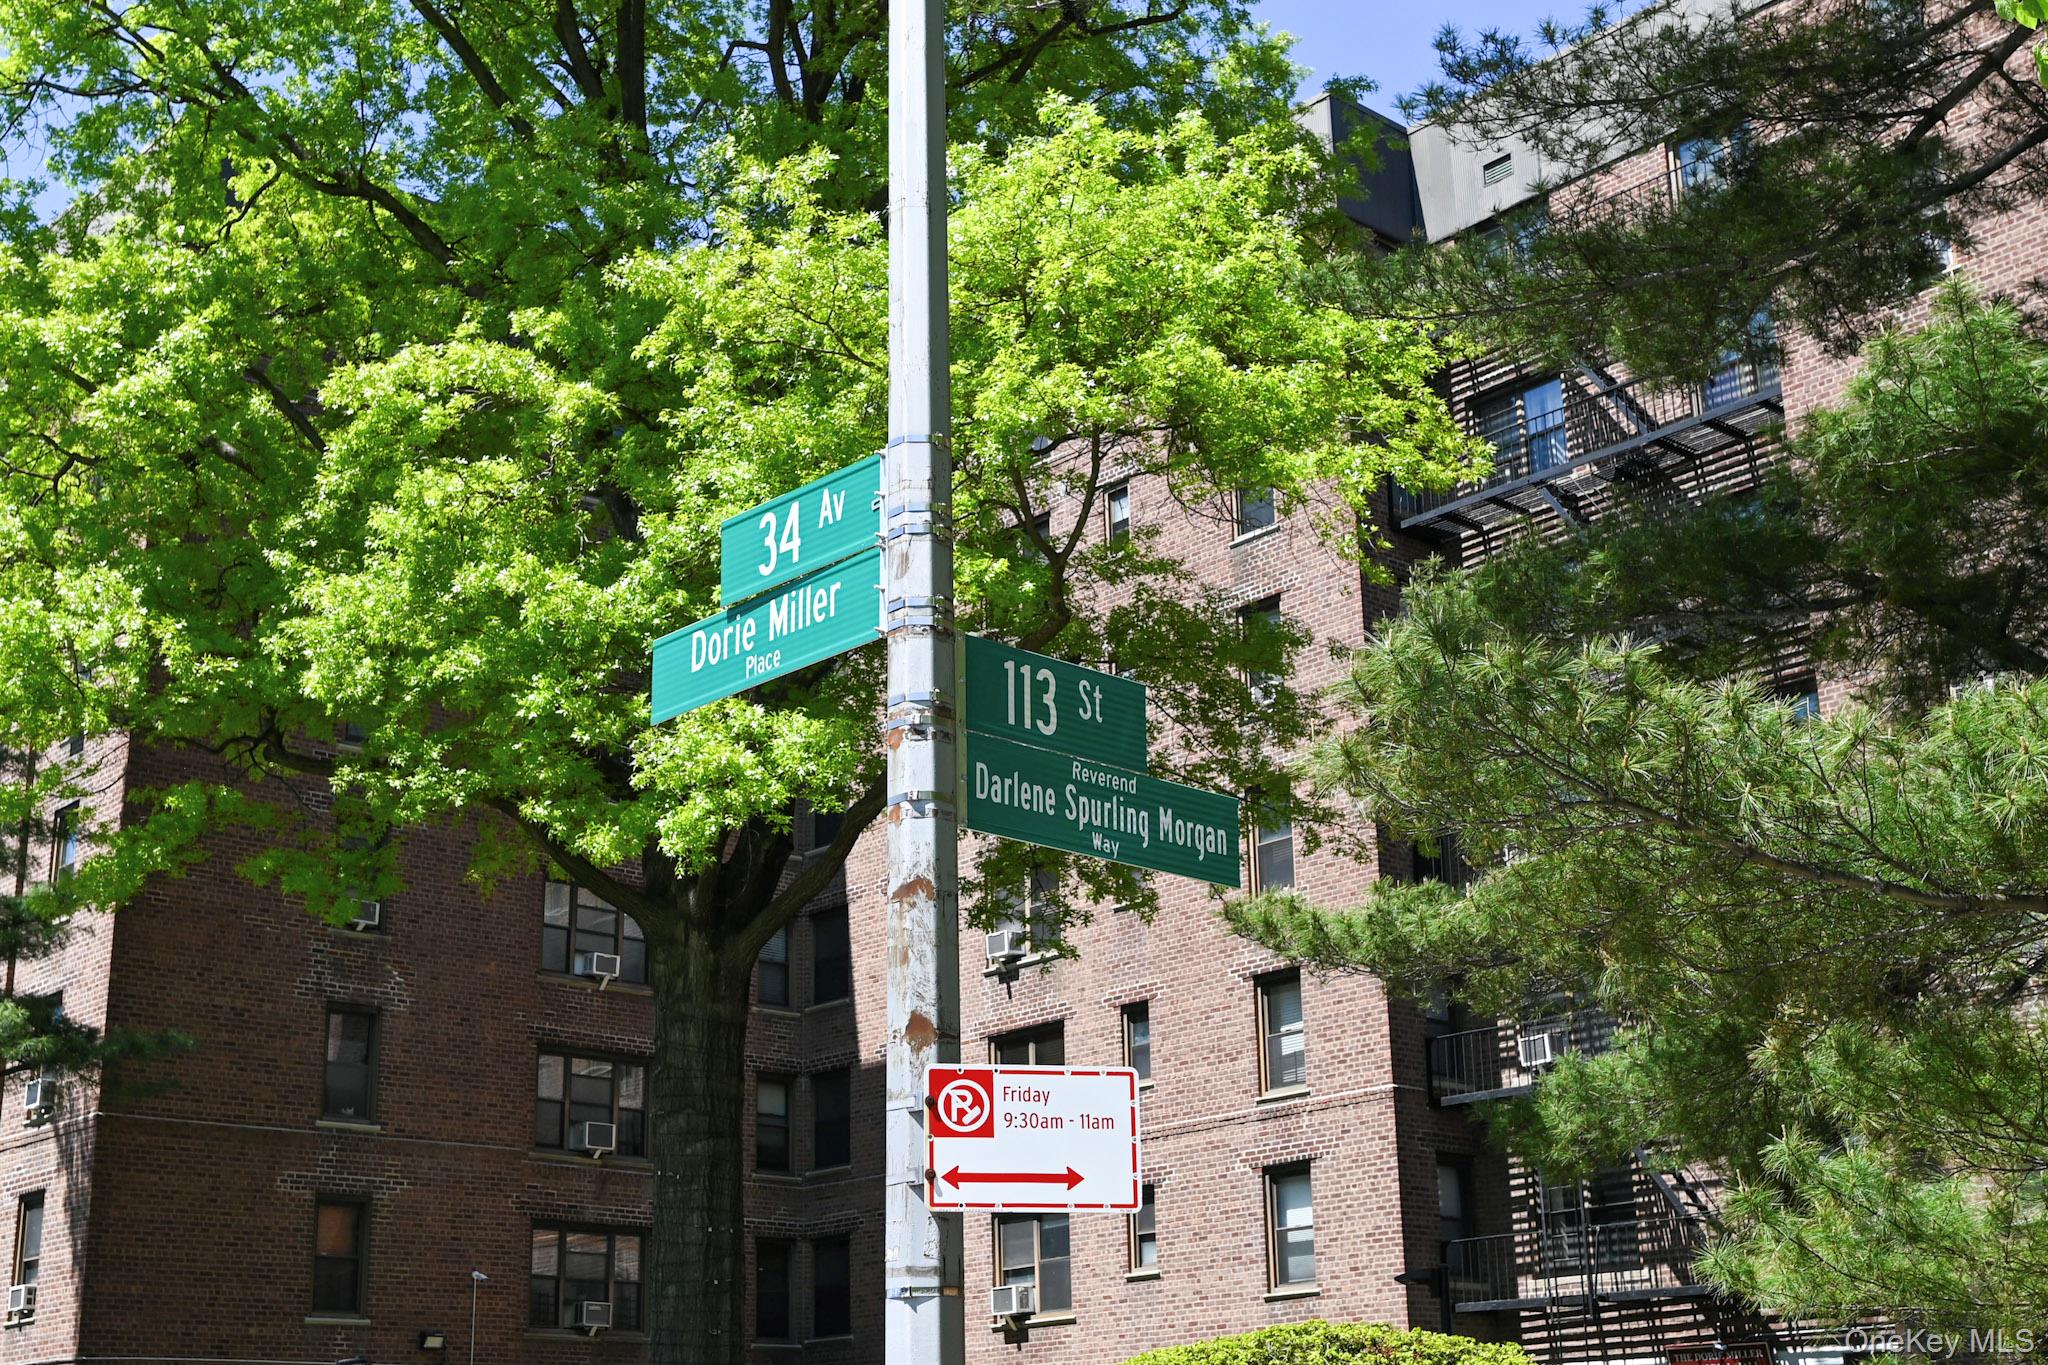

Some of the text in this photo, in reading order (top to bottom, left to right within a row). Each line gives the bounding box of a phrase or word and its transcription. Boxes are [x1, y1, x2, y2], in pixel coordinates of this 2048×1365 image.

[758, 488, 846, 577] 34 Av
[690, 582, 843, 673] Dorie Miller
[745, 648, 781, 679] Place
[1004, 660, 1102, 735] 113 St
[1072, 762, 1137, 793] Reverend
[976, 763, 1227, 860] Darlene Spurling Morgan
[1091, 832, 1120, 859] Way
[1004, 1086, 1050, 1106] Friday
[1004, 1113, 1063, 1129] 9:30am
[1080, 1114, 1115, 1129] 11am
